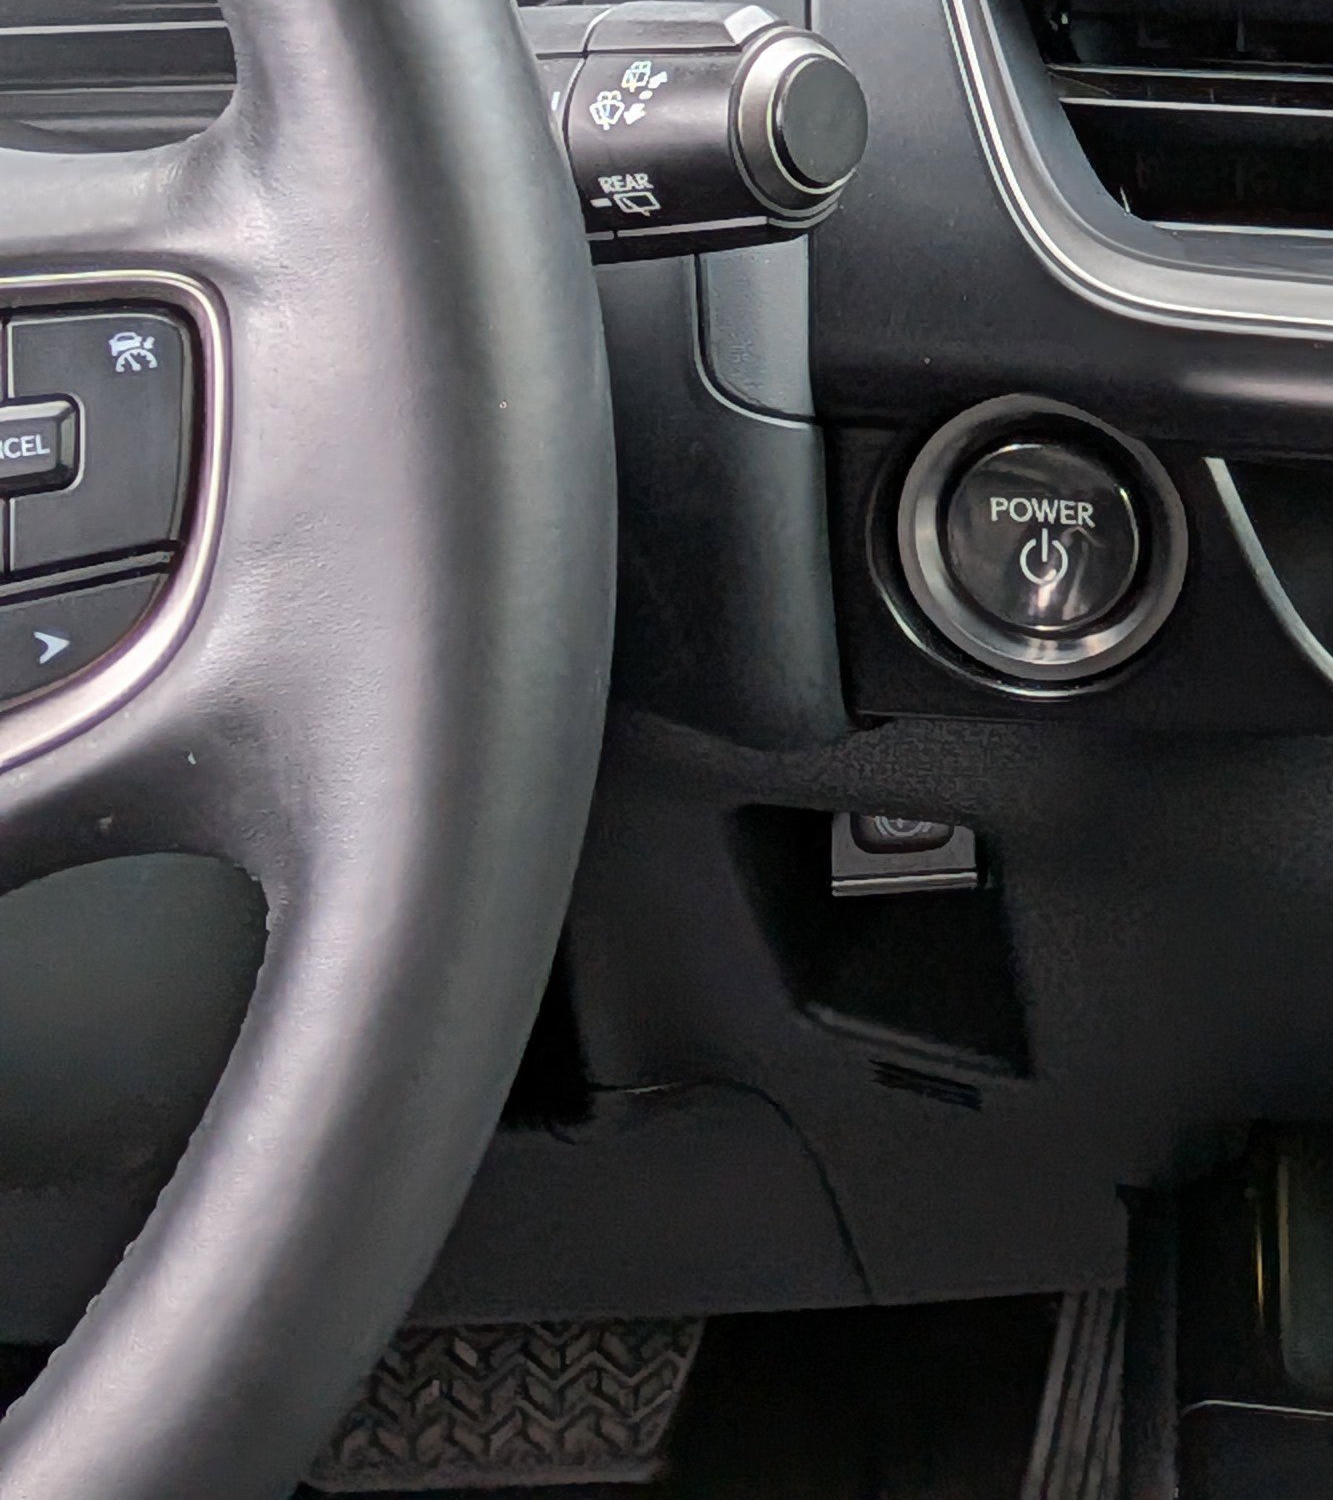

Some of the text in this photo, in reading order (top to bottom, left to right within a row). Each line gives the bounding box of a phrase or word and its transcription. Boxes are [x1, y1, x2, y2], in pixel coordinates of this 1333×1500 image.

[598, 174, 654, 193] REAR
[0, 434, 50, 458] CEL
[990, 497, 1096, 528] POWER
